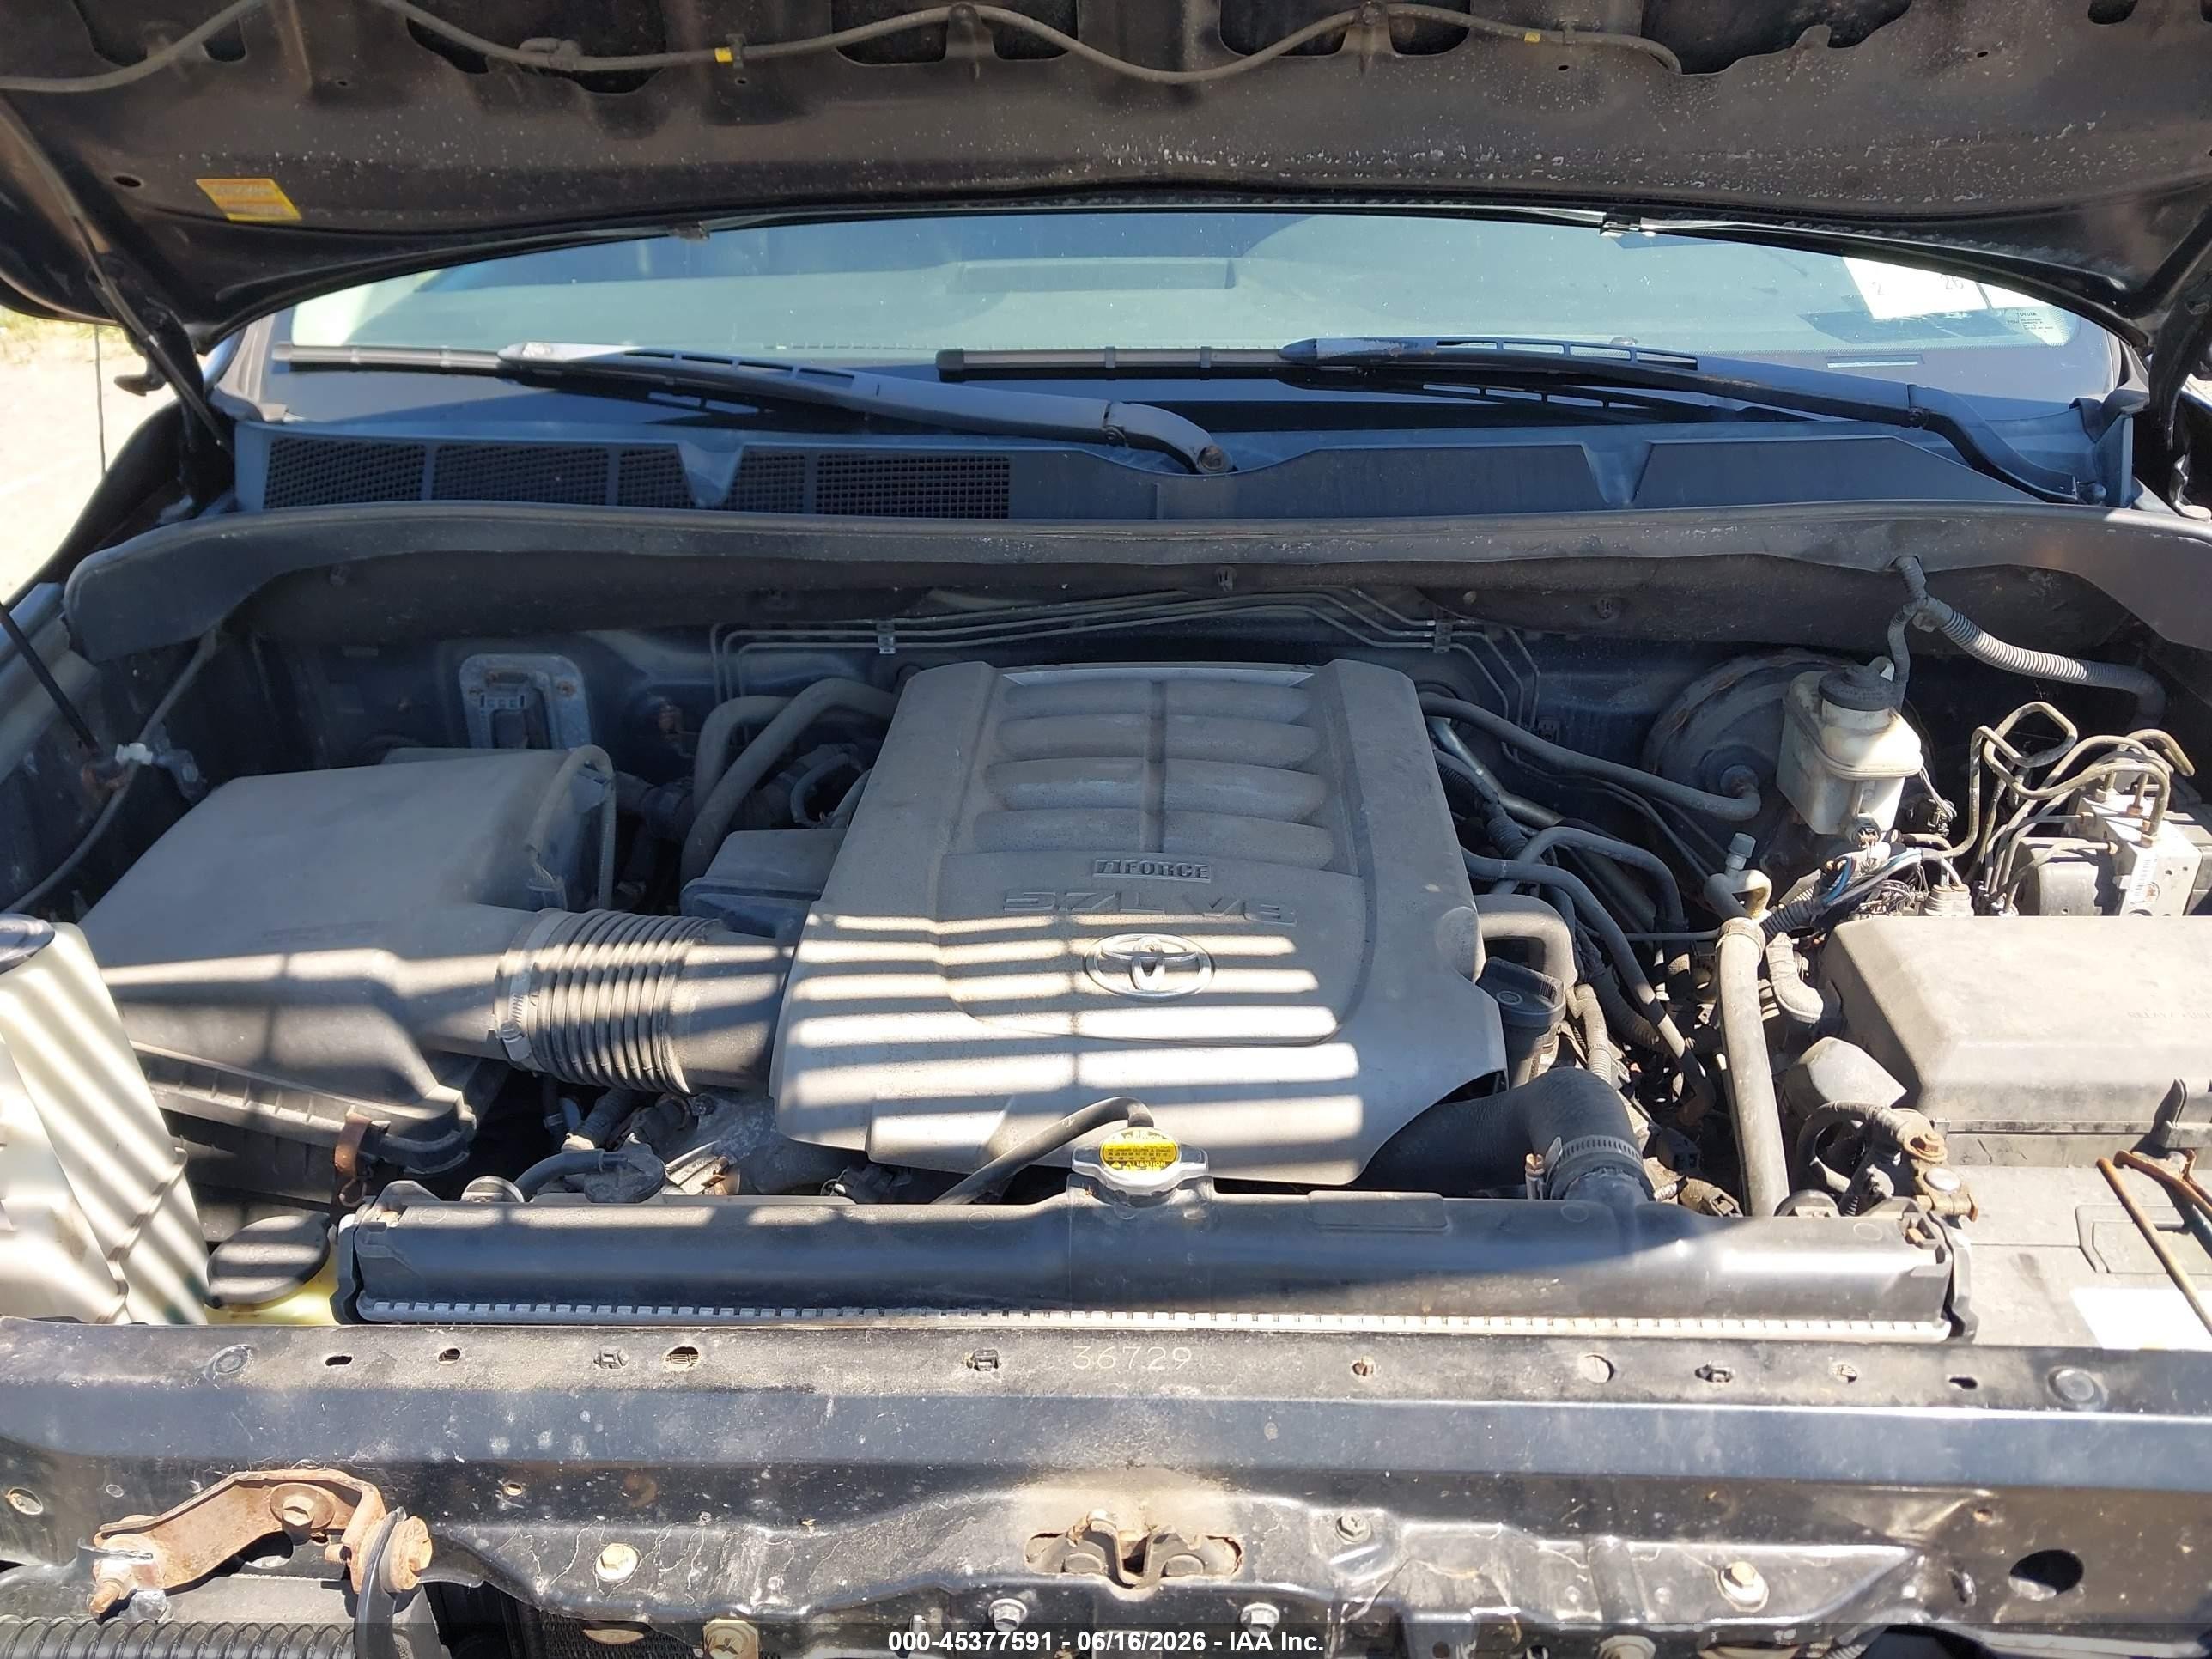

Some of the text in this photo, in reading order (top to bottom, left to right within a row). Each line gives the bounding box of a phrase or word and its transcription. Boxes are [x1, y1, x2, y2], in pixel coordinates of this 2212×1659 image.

[1003, 889, 1298, 927] 5.7L V8
[1073, 1345, 1193, 1370] 36729
